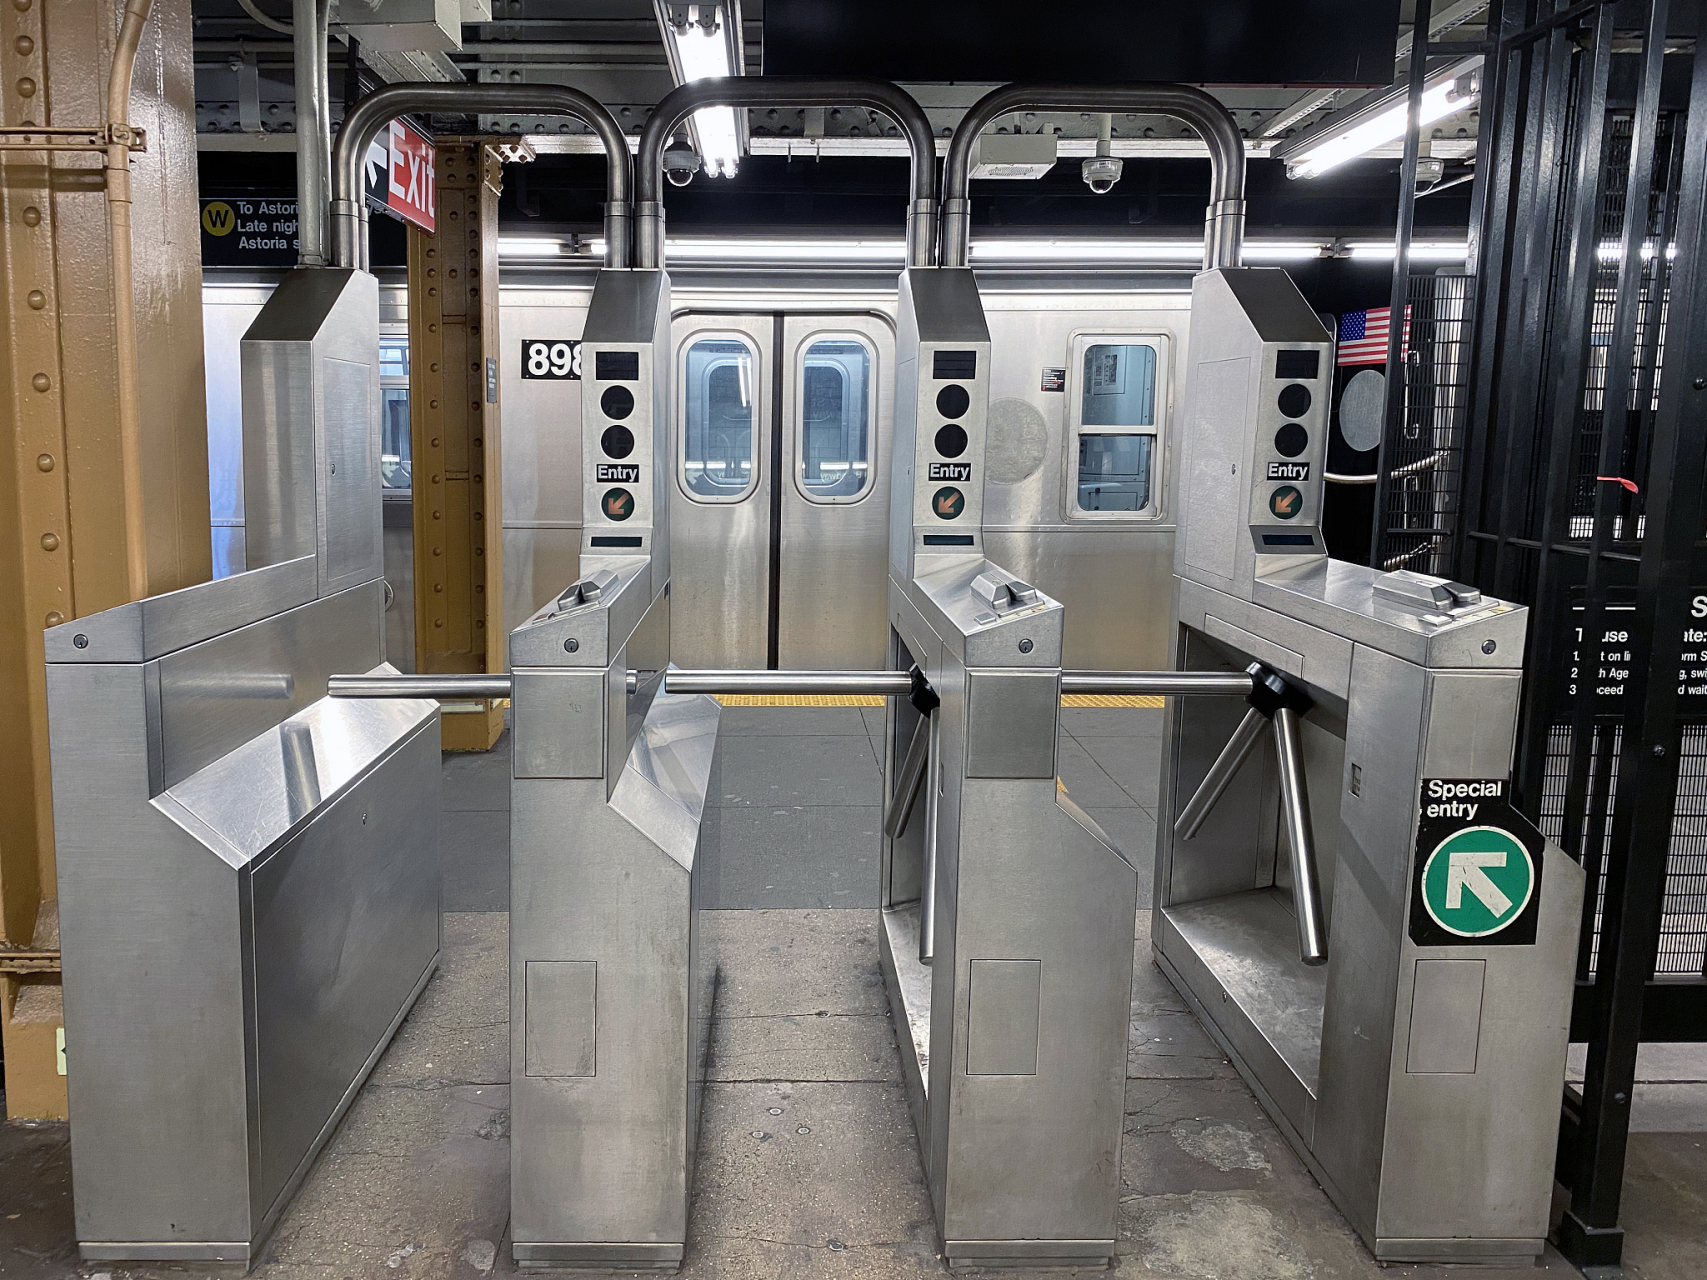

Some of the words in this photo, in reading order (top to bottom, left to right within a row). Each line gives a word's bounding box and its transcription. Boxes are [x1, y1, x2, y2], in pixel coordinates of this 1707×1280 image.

[389, 119, 435, 218] Exit
[237, 201, 253, 214] To
[258, 201, 298, 214] Astori
[207, 209, 229, 229] W
[237, 219, 267, 232] Late
[272, 219, 299, 235] nigh
[238, 236, 287, 249] Astoria
[597, 465, 638, 482] Entry
[929, 464, 970, 480] Entry
[1268, 463, 1308, 480] Entry
[1607, 653, 1621, 661] on
[1608, 667, 1629, 680] Age
[1428, 779, 1502, 800] Special
[1427, 801, 1478, 820] entry
